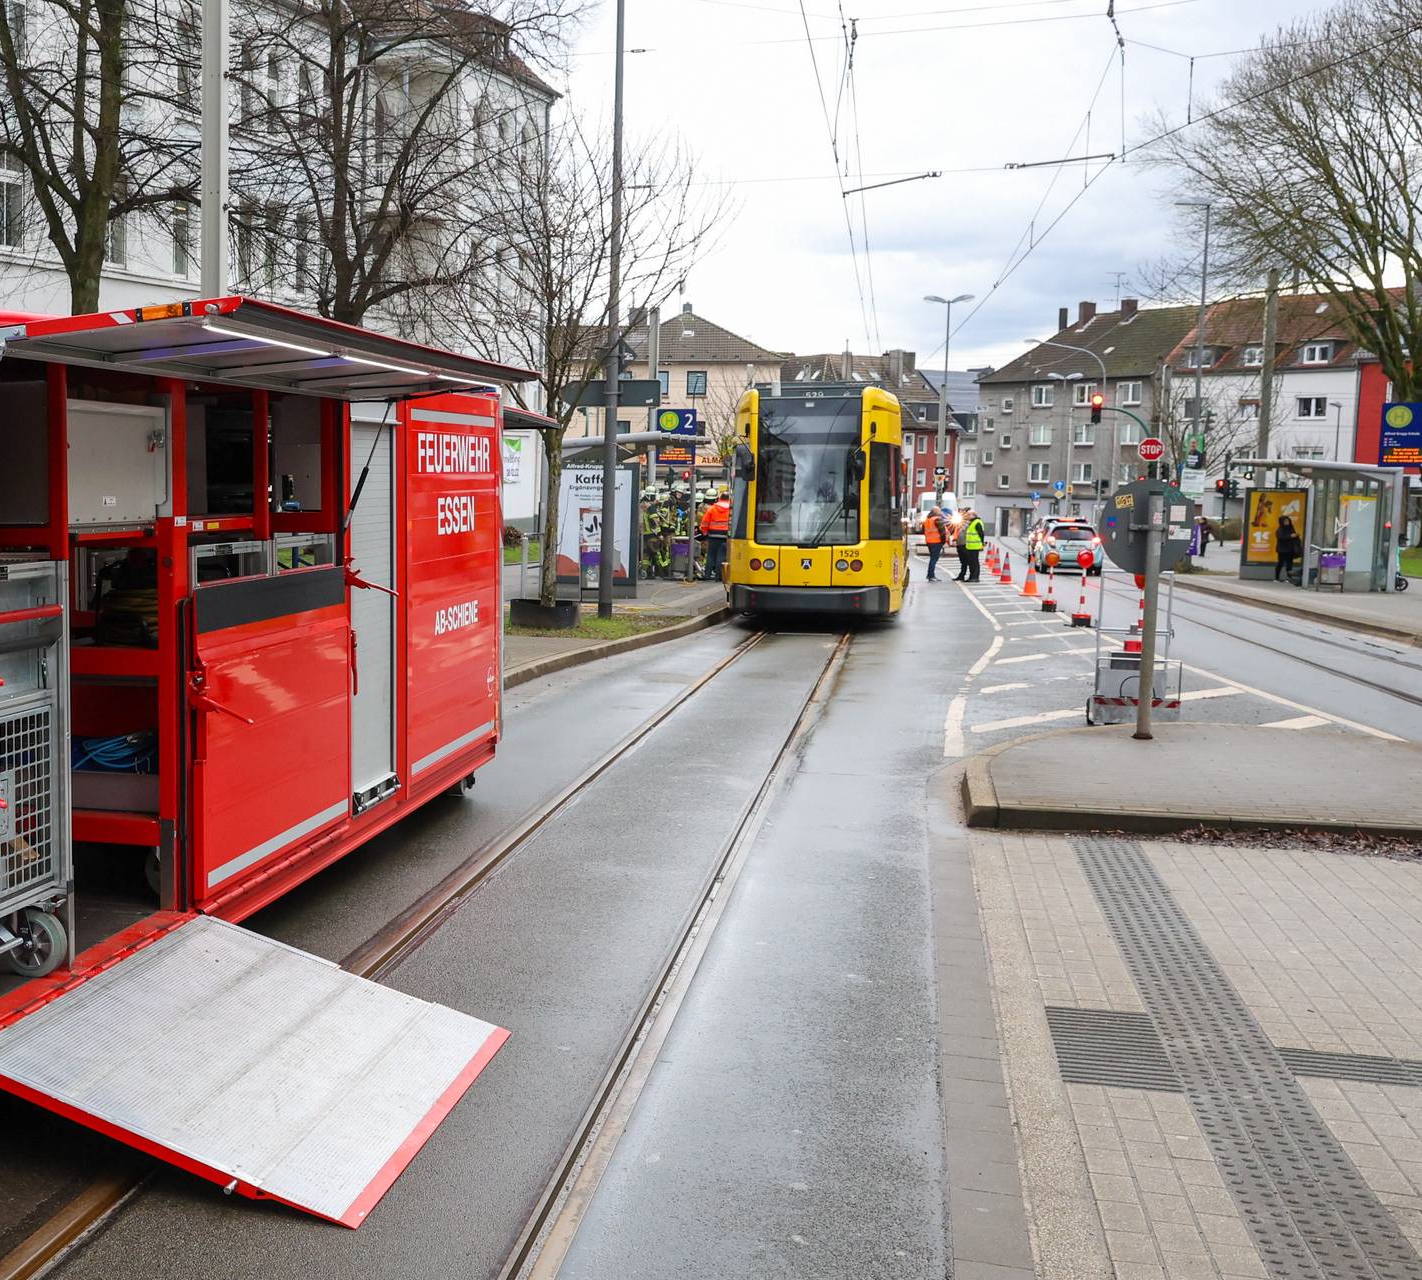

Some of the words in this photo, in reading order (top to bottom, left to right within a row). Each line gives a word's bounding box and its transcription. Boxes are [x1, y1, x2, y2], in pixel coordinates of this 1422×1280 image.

[684, 414, 693, 429] 2
[418, 432, 490, 473] FEUERWEHR
[1140, 444, 1162, 455] STOP
[437, 496, 475, 536] ESSEN
[839, 550, 860, 558] 1529
[434, 600, 479, 636] AB-SCHIENE
